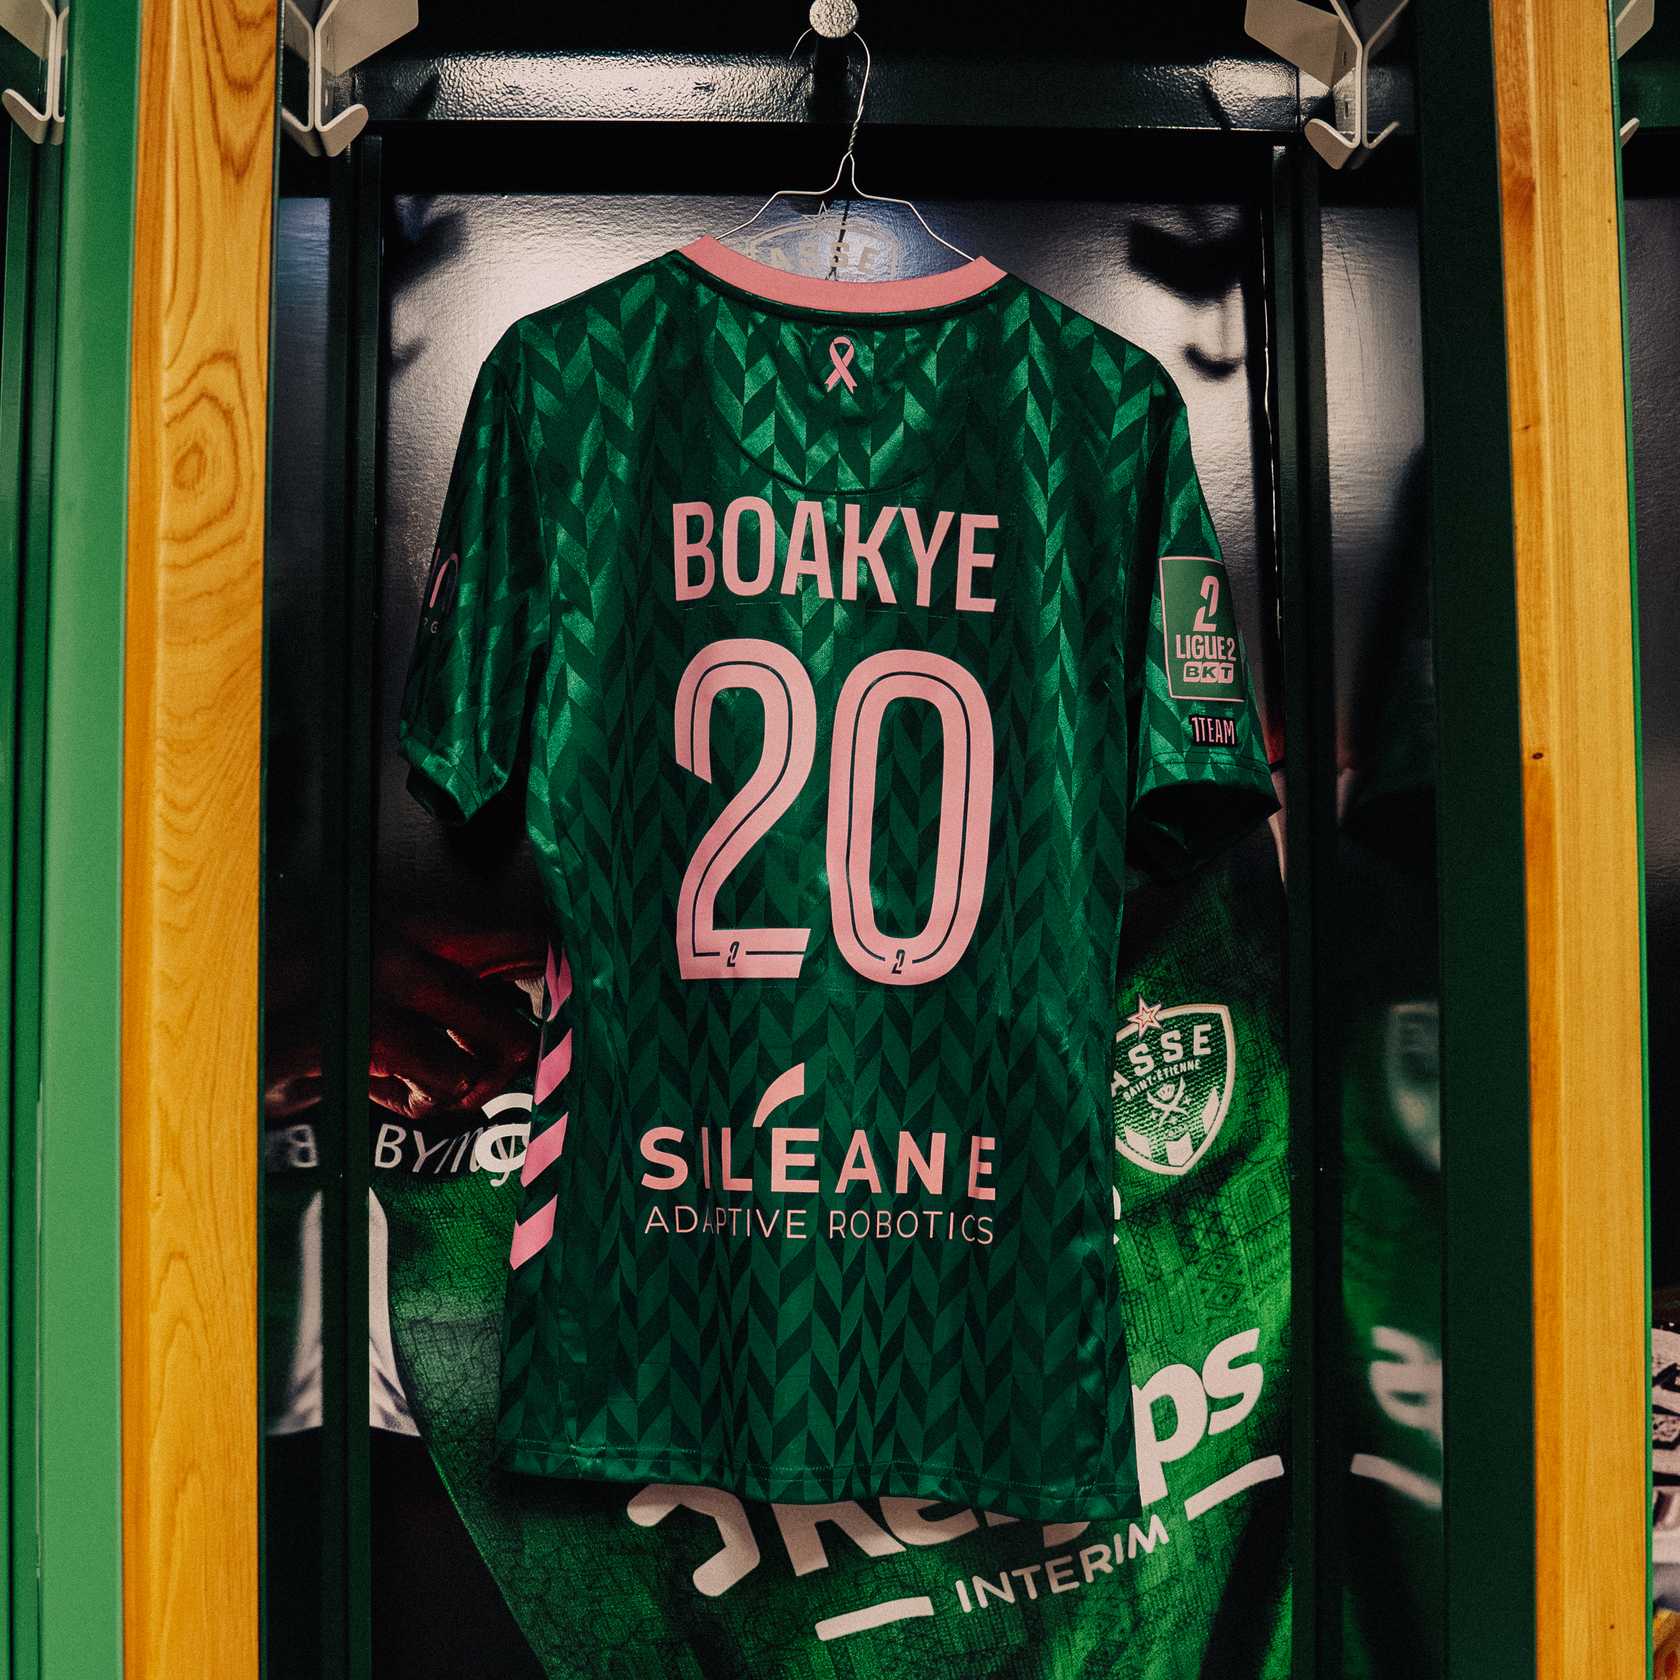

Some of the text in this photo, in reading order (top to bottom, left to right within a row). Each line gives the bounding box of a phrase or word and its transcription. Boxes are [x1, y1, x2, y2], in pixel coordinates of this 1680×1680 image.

[673, 496, 1000, 613] BOAKYE
[1193, 575, 1220, 633] 2
[1184, 663, 1234, 682] BKT
[674, 638, 995, 986] 20
[644, 1205, 994, 1245] ADAPTIVE ROBOTICS
[955, 1514, 1170, 1613] INTERIM
